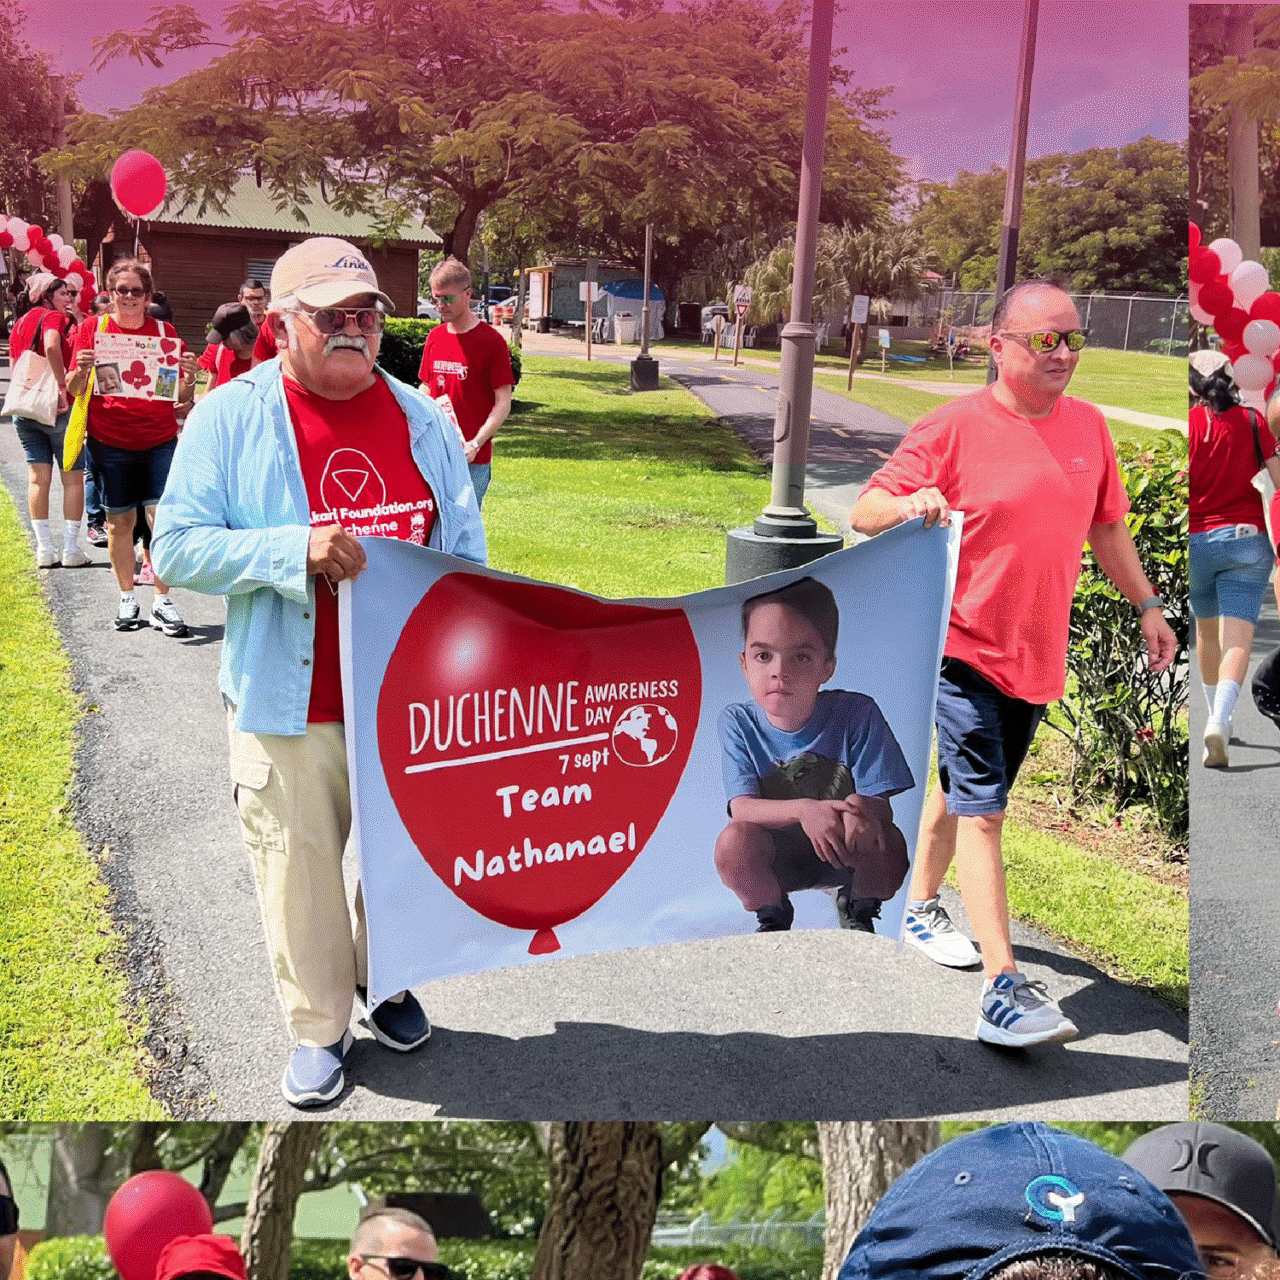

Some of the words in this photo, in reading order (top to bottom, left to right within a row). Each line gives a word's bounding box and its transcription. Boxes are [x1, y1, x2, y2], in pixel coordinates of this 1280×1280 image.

[340, 498, 434, 519] Foundation.org
[344, 521, 398, 536] chenne
[408, 680, 581, 756] DUCHENNE
[584, 680, 679, 704] AWARENESS
[585, 704, 615, 726] DAY
[558, 755, 570, 775] 7
[574, 748, 610, 773] sept
[496, 781, 593, 819] Team
[453, 823, 637, 886] Nathanael
